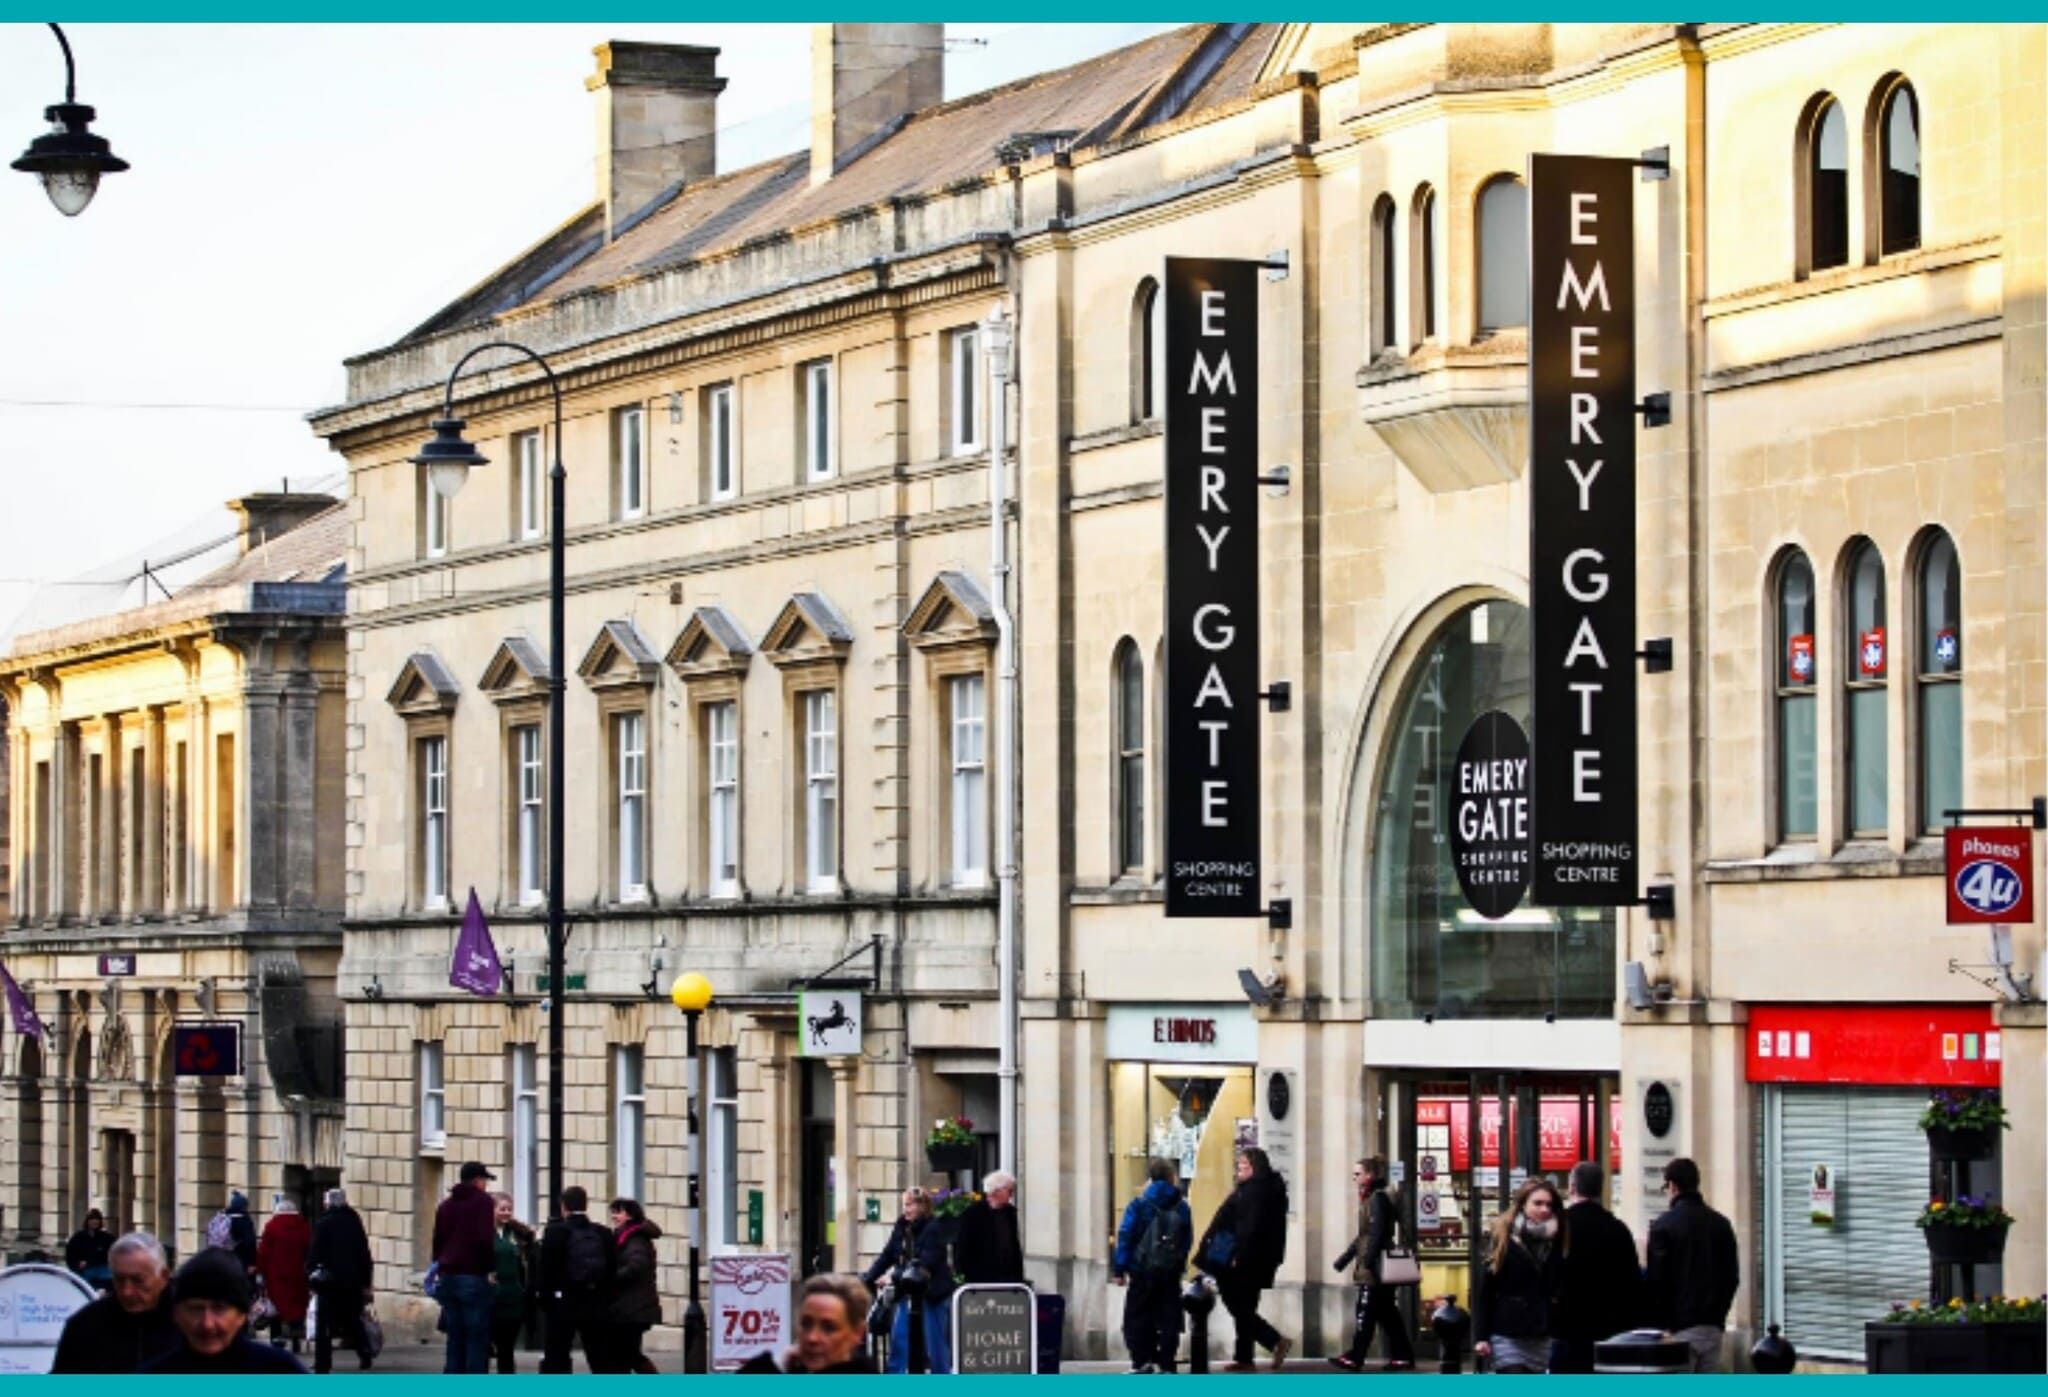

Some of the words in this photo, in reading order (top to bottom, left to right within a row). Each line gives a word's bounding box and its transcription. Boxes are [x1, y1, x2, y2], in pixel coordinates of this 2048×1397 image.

[1556, 191, 1612, 512] EMERY
[1188, 288, 1238, 572] EMERY
[1561, 547, 1609, 803] GATE
[1193, 602, 1235, 828] GATE
[1461, 757, 1528, 794] EMERY
[1458, 797, 1528, 844] GATE
[1461, 849, 1528, 867] SHOPPING
[1541, 842, 1632, 861] SHOPPING
[1962, 836, 2021, 860] phones
[1174, 861, 1255, 878] SHOPPING
[1554, 865, 1620, 883] CENTRE
[1185, 881, 1243, 896] CENTRE
[1962, 863, 2016, 908] 4u
[966, 1331, 1023, 1347] HOME
[963, 1352, 977, 1367] &
